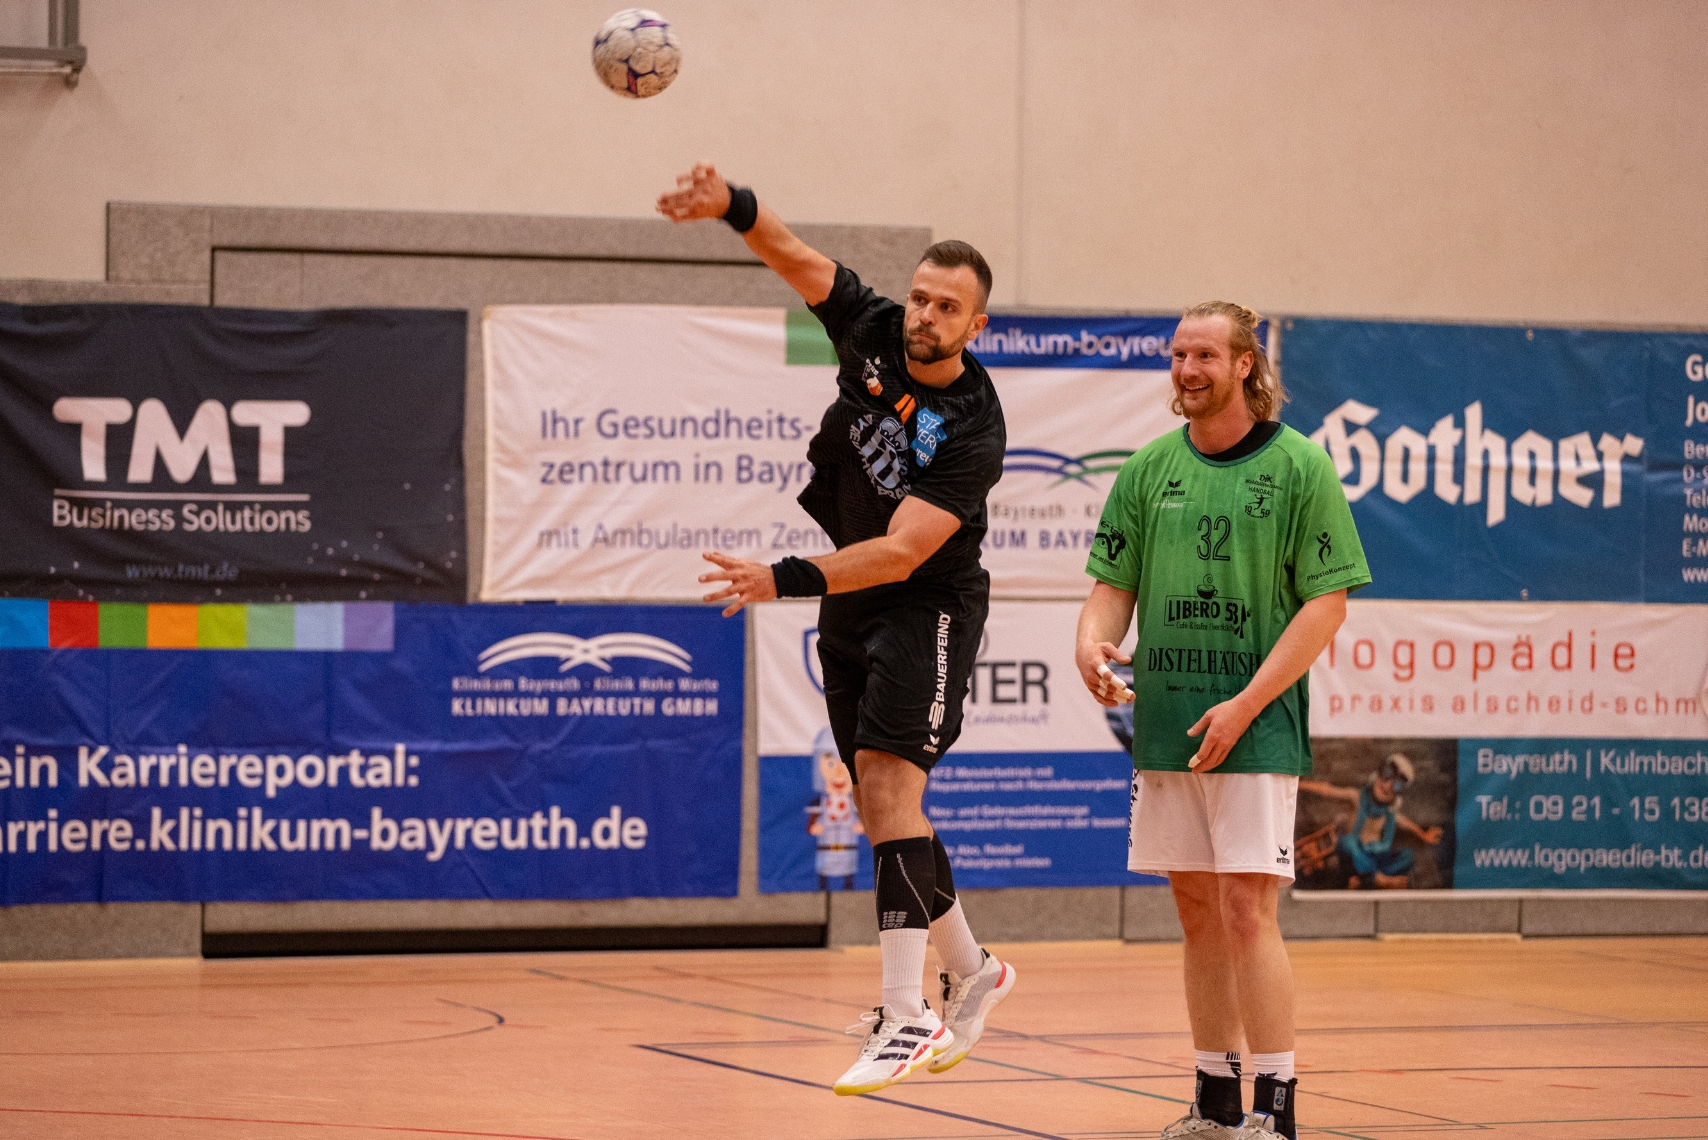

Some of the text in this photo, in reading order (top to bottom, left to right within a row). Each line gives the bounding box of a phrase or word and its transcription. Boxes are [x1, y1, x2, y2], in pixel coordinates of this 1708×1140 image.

[541, 408, 814, 440] Ihr Gesundheits-
[53, 397, 311, 484] TMT
[540, 453, 815, 492] zentrum in Bayr
[1308, 399, 1644, 527] Gothaer
[53, 500, 311, 533] Business Solutions
[538, 524, 579, 549] mit
[592, 521, 762, 550] Ambulantem
[1197, 515, 1230, 561] 32
[125, 562, 239, 581] www.tmt.de
[1306, 562, 1356, 581] PhysioKonzept
[1168, 600, 1239, 625] LIBERO 53
[935, 613, 950, 702] BAUERFEIND
[1328, 630, 1636, 682] logopädie
[451, 676, 514, 692] Klinikum
[518, 676, 581, 695] Bayreuth
[593, 676, 635, 692] Klinik
[678, 676, 719, 692] Warte
[451, 697, 719, 717] KLINIKUM BAYREUTH GMBH
[1329, 690, 1698, 717] praxis alscheid-schm
[78, 743, 420, 798] Karriereportal:
[1477, 748, 1577, 779] Bayreuth
[1600, 748, 1708, 776] Kulmbach
[1475, 795, 1520, 821] Tel.:
[1529, 795, 1563, 821] 09
[1571, 795, 1600, 821] 21
[1633, 795, 1660, 821] 15
[0, 805, 648, 861] rriere.klinikum-bayreuth.de
